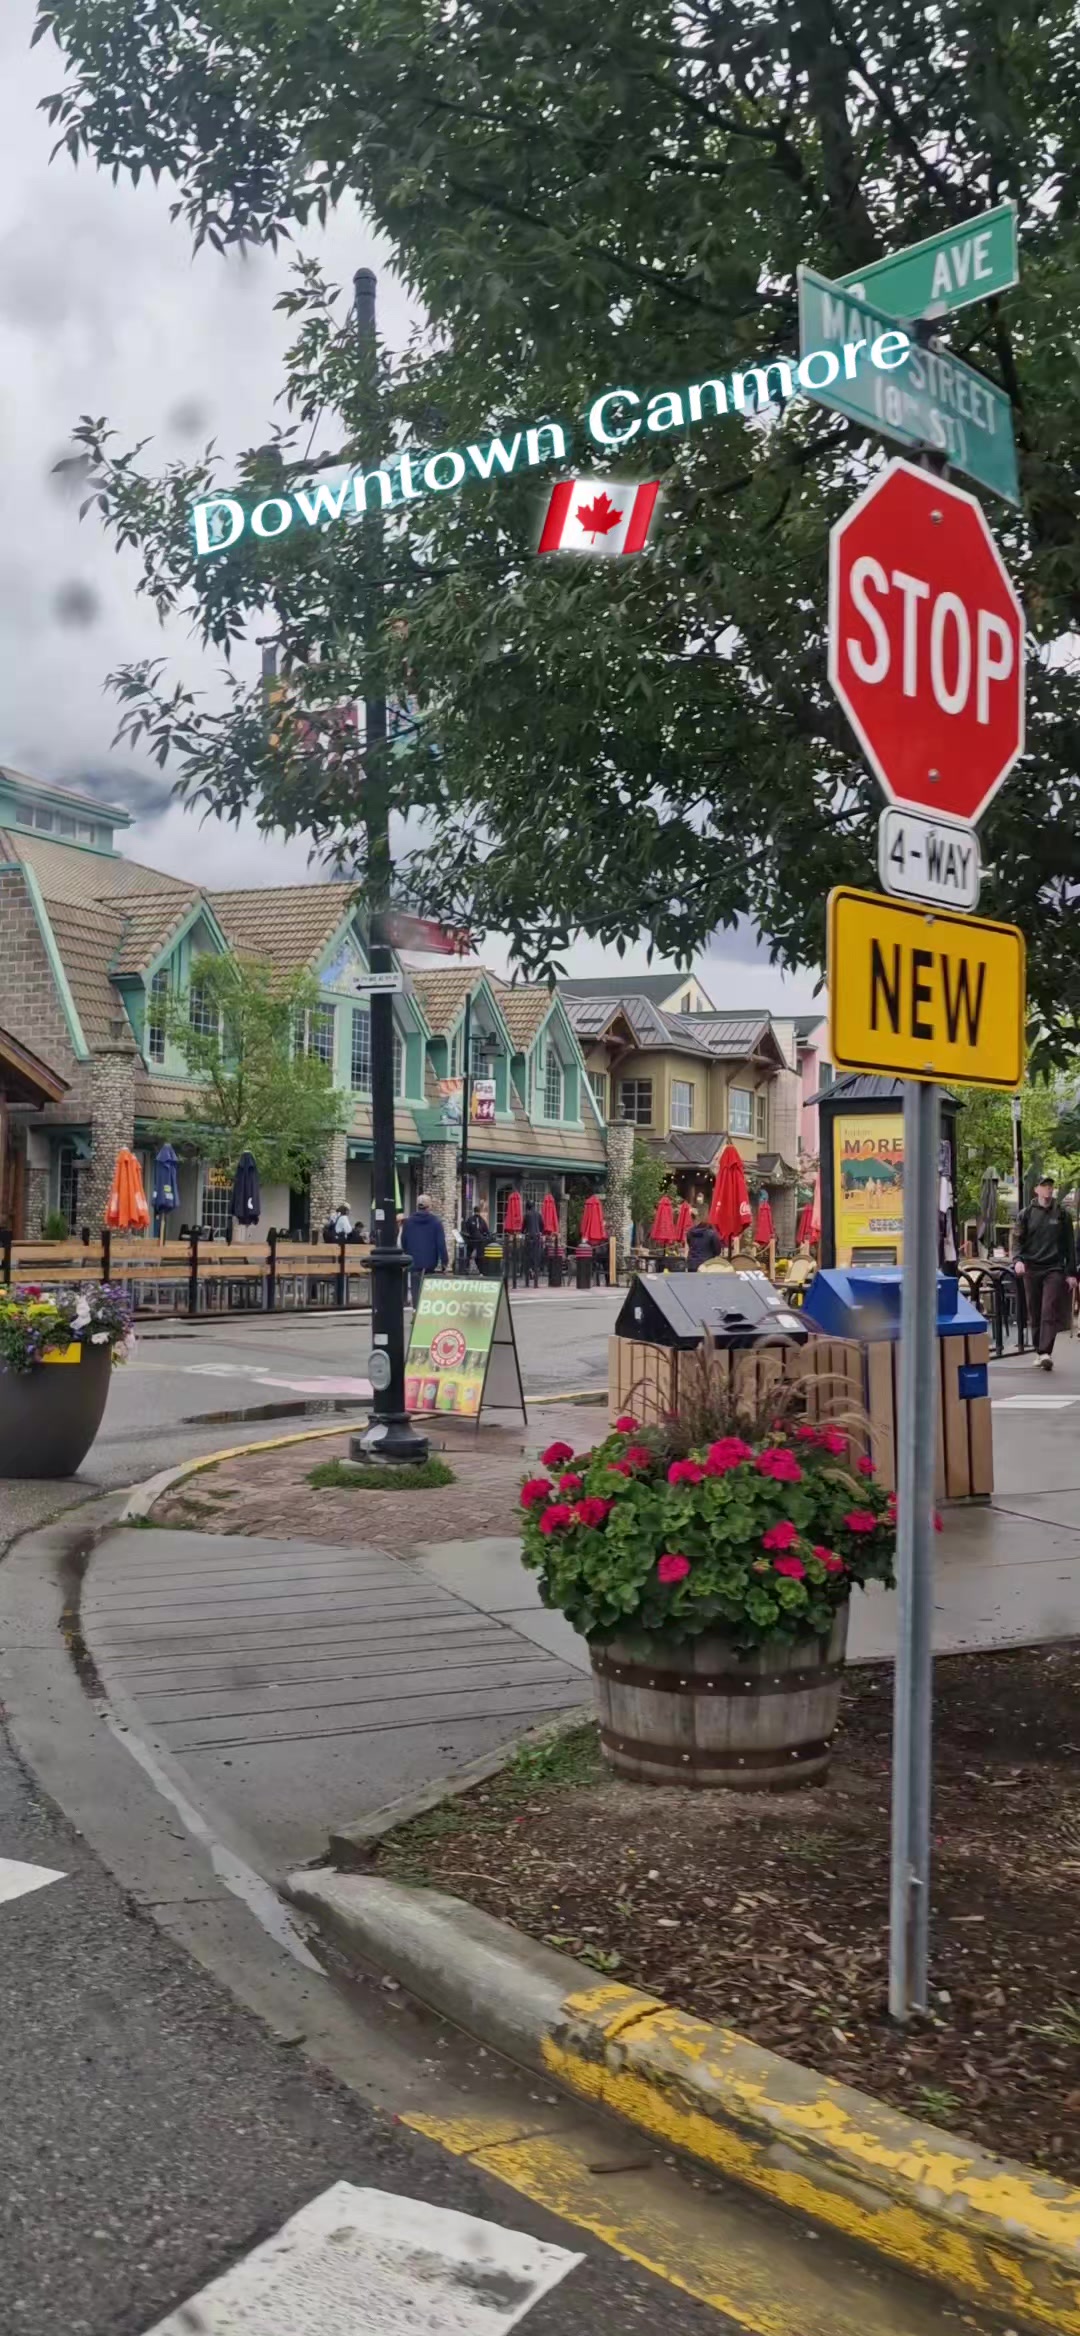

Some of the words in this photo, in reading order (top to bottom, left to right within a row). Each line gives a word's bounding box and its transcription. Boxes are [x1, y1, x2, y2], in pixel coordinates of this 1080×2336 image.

[931, 231, 993, 299] AVE
[907, 343, 995, 434] STREET
[846, 555, 1014, 725] STOP
[889, 829, 972, 892] 4-WAY
[869, 938, 986, 1048] NEW
[844, 1138, 903, 1153] MORE
[419, 1300, 495, 1317] BOOSTS
[423, 1279, 499, 1293] SMOOTHIES
